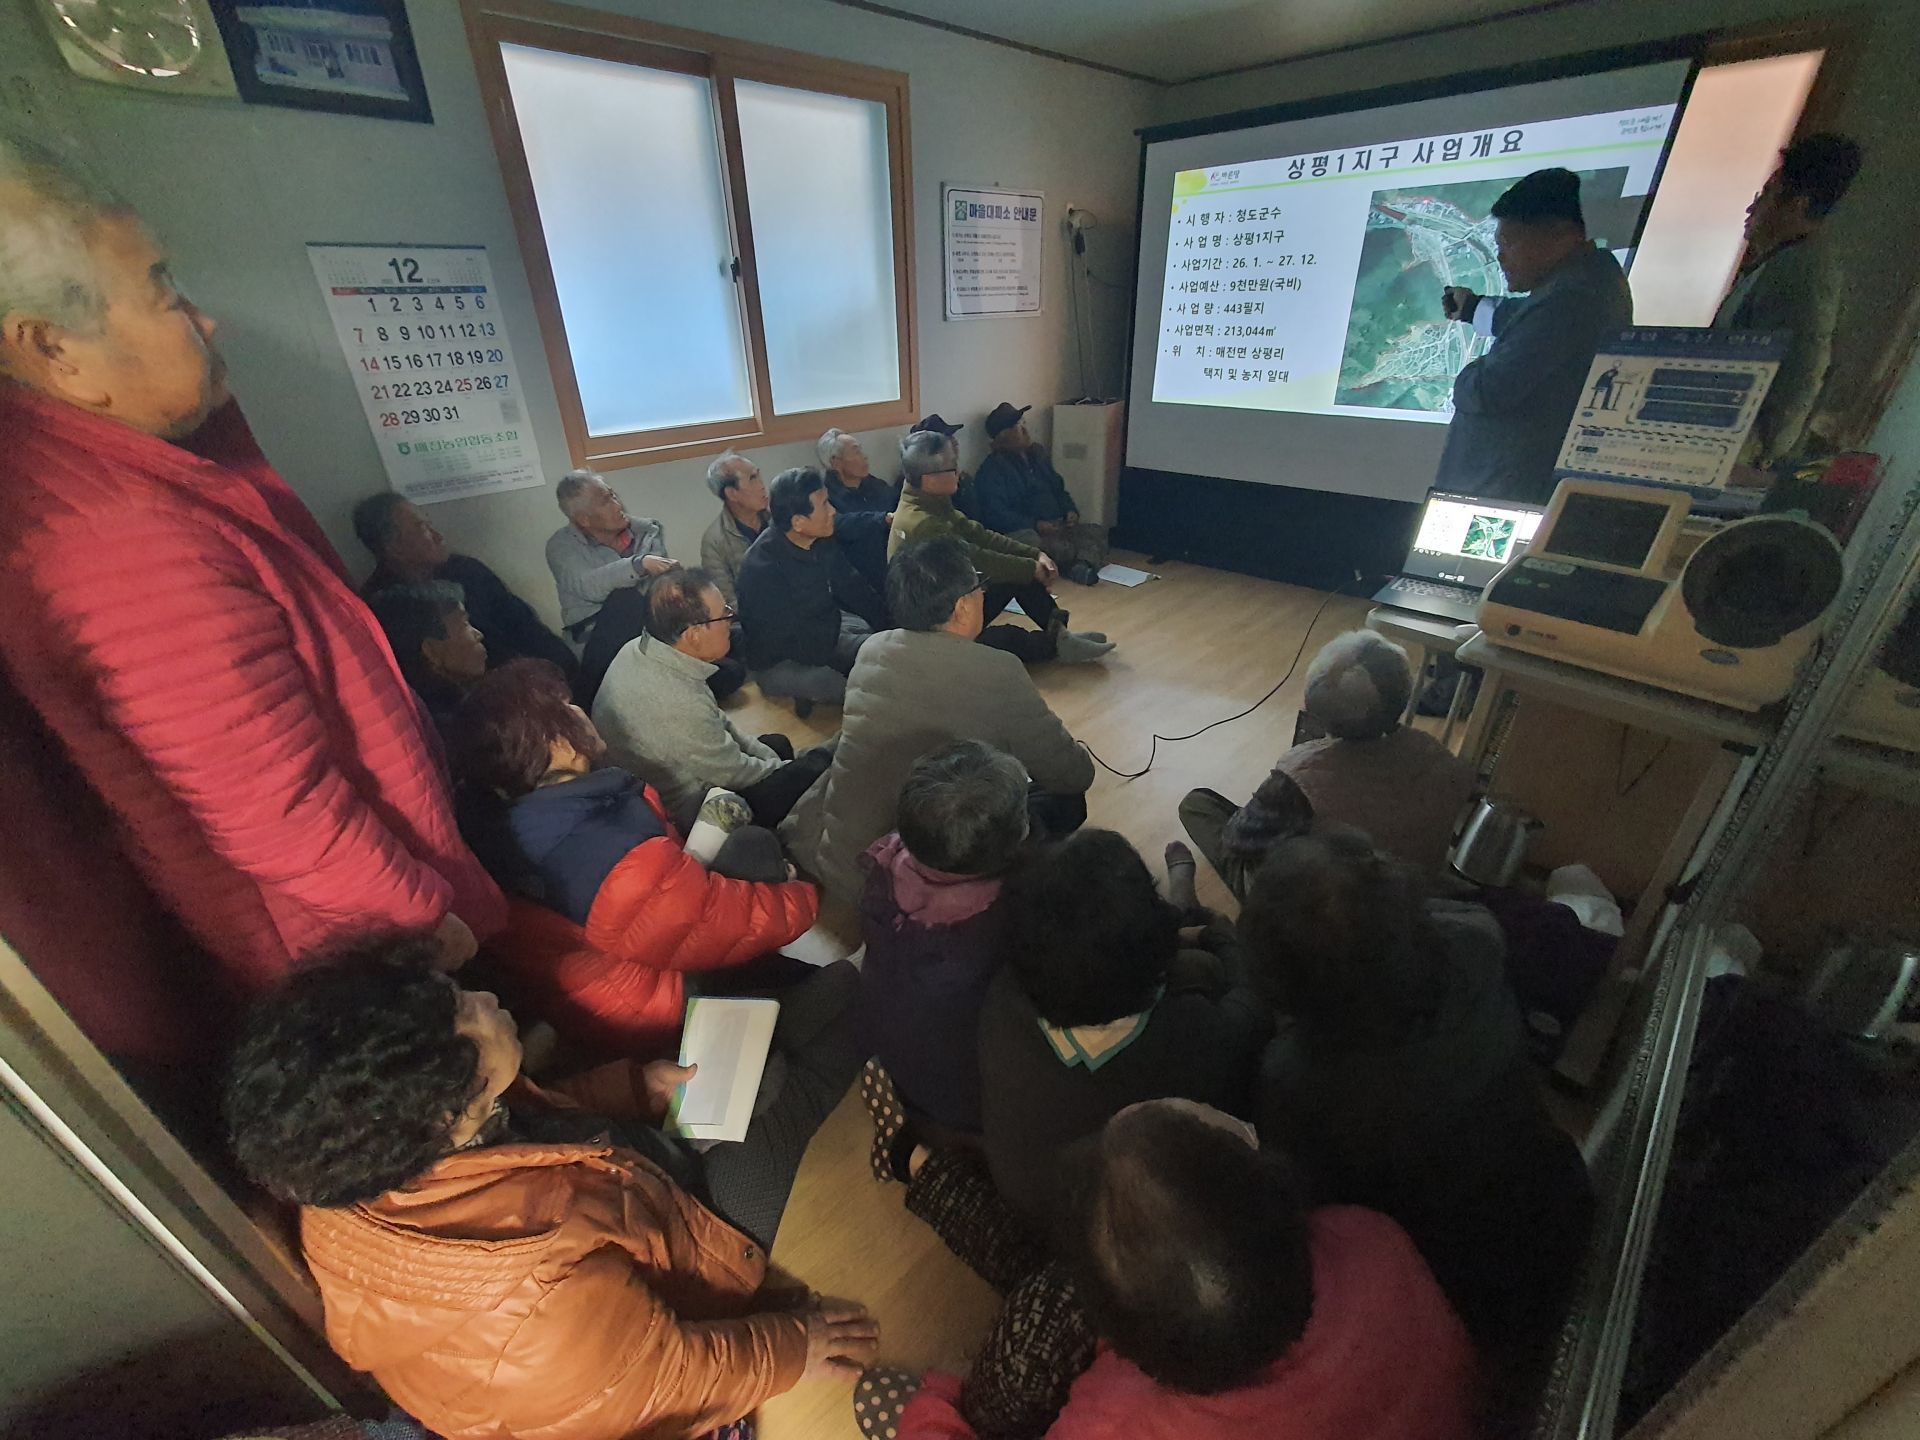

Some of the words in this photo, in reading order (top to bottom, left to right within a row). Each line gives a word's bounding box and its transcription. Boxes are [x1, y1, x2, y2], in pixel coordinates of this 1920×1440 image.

[970, 203, 1011, 219] 마을대피소
[1014, 206, 1036, 221] 안내문
[1236, 206, 1282, 223] 청도군수
[1233, 230, 1285, 246] 상평1지구
[388, 257, 423, 283] 12
[1182, 255, 1222, 271] 사업기간
[1233, 258, 1248, 269] 26.
[1254, 257, 1262, 268] 1.
[1278, 255, 1295, 266] 27.
[1301, 254, 1317, 265] 12.
[1179, 280, 1219, 293] 사업예산
[1230, 277, 1301, 292] 9천만원(국비)
[368, 298, 376, 313] 1
[390, 297, 401, 312] 2
[412, 297, 423, 311] 3
[435, 296, 444, 310] 4
[455, 295, 465, 310] 5
[475, 295, 485, 309] 6
[1224, 302, 1264, 315] 443필지
[353, 328, 363, 343] 7
[377, 327, 389, 341] 8
[400, 326, 410, 340] 9
[417, 326, 435, 339] 10
[439, 325, 455, 338] 11
[459, 323, 476, 337] 12
[479, 322, 496, 336] 13
[1175, 325, 1214, 336] 사업면적
[361, 357, 380, 371] 14
[383, 356, 401, 370] 15
[405, 354, 423, 369] 16
[426, 353, 442, 367] 17
[447, 352, 464, 366] 18
[467, 350, 483, 364] 19
[486, 349, 503, 363] 20
[1216, 346, 1247, 359] 매전면
[1251, 347, 1284, 360] 상평리
[1204, 367, 1223, 380] 택지
[1228, 368, 1237, 381] 및
[1242, 369, 1262, 381] 농지
[1267, 370, 1289, 383] 일대
[371, 385, 390, 400] 21
[392, 383, 412, 398] 22
[413, 381, 433, 396] 23
[435, 380, 453, 394] 24
[455, 378, 472, 391] 25
[474, 377, 492, 390] 26
[494, 375, 508, 388] 27
[380, 413, 399, 427] 28
[402, 410, 420, 425] 29
[423, 408, 440, 422] 30
[443, 406, 460, 420] 31
